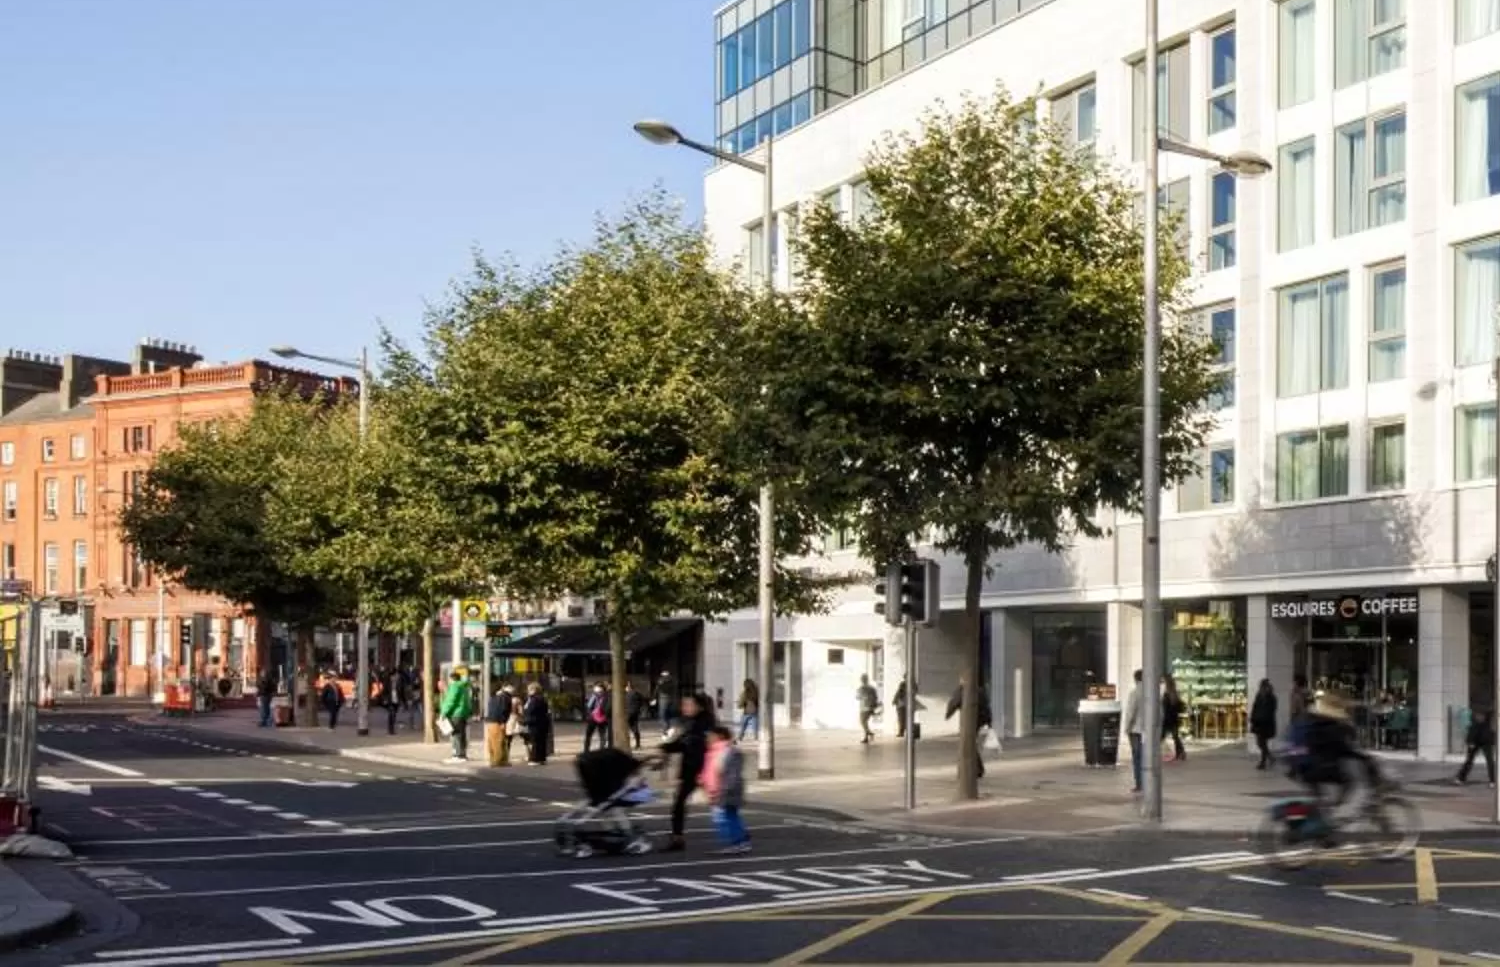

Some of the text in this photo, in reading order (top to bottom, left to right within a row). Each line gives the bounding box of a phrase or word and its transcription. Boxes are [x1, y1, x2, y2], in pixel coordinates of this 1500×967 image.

[1271, 597, 1417, 618] ESQUIRES COFFEE
[249, 859, 973, 935] NO ENTRY
